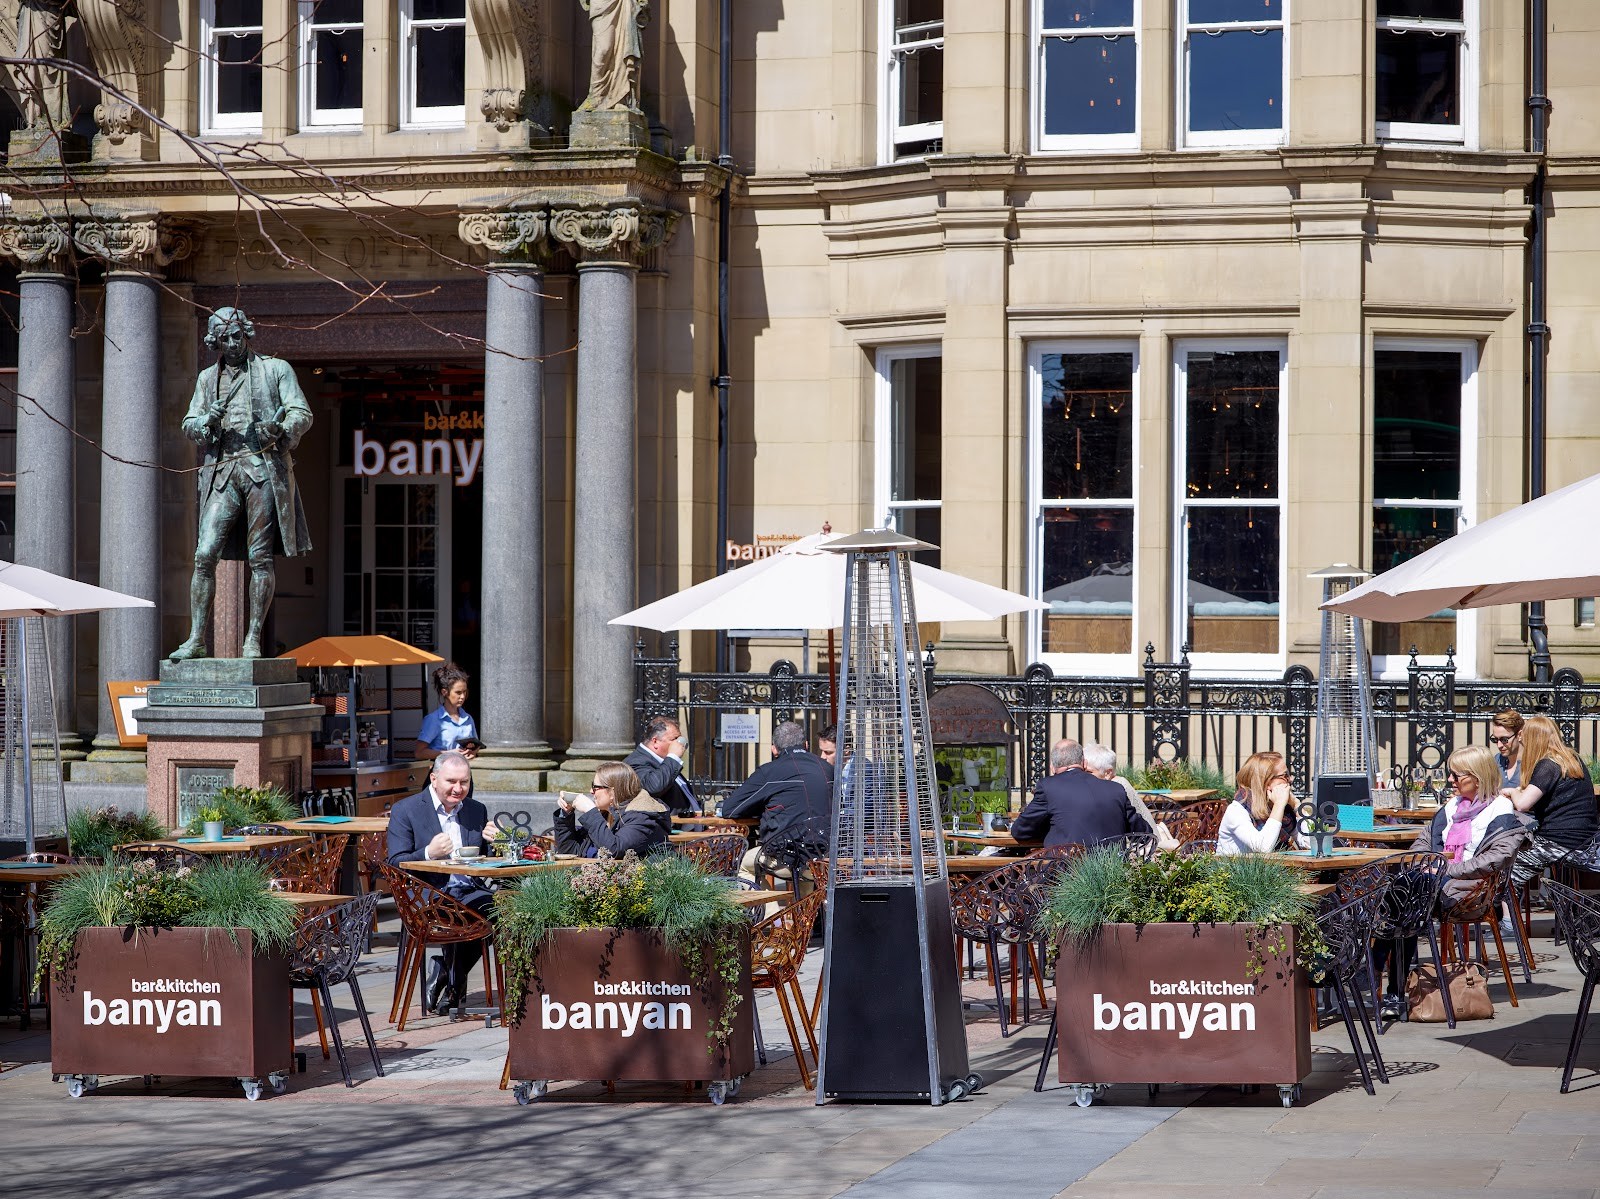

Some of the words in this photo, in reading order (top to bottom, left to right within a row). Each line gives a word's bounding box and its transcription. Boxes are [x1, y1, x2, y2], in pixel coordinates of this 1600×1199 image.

[216, 237, 332, 272] POST
[344, 233, 480, 269] OFFIC
[354, 429, 484, 486] bany
[189, 774, 225, 788] JOSEPH
[131, 978, 221, 993] bar&kitchen
[593, 981, 691, 996] bar&kitchen
[1149, 980, 1255, 996] bar&kitchen
[83, 991, 222, 1034] banyan
[541, 994, 692, 1038] banyan
[1093, 993, 1256, 1040] banyan
